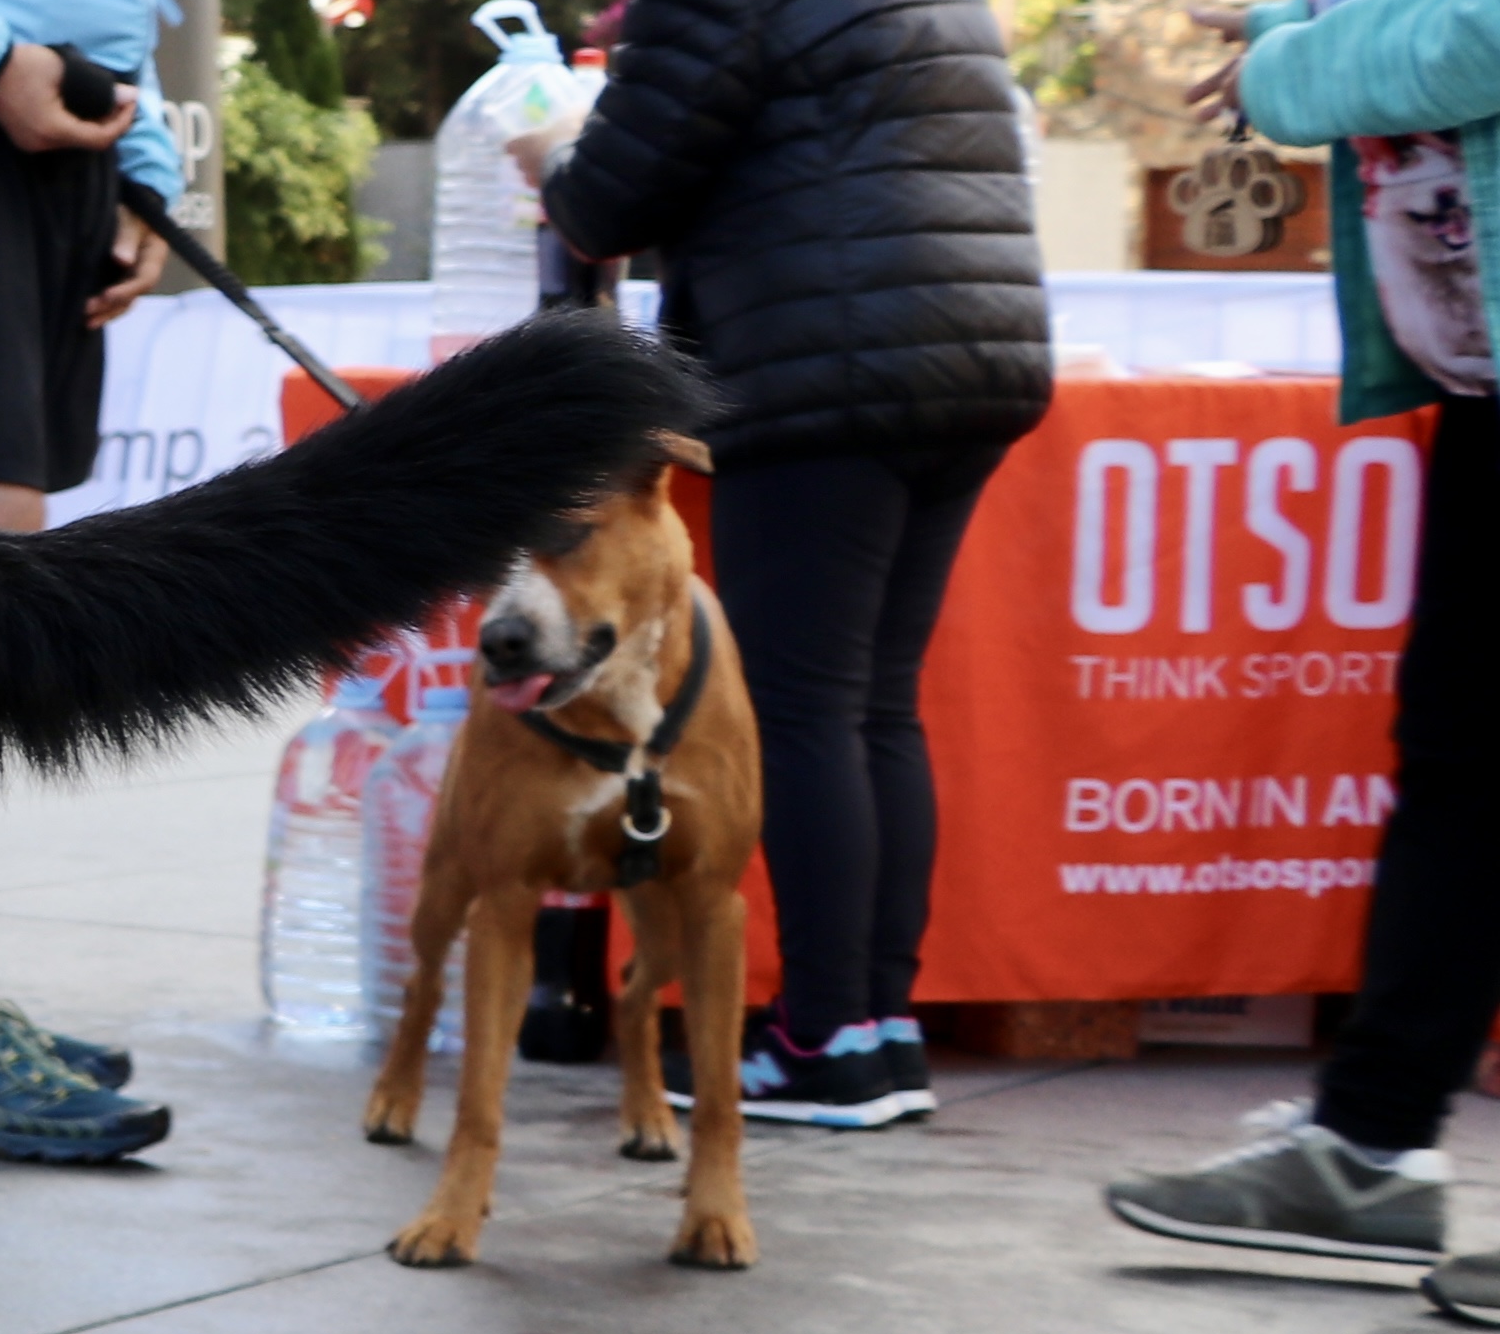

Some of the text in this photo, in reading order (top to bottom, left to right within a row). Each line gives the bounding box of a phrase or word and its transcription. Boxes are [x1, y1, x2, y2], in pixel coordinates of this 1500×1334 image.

[1070, 436, 1423, 634] OTSO
[1067, 651, 1400, 701] THINK SPORT
[1063, 778, 1239, 833] BORN
[1249, 776, 1307, 828] IN
